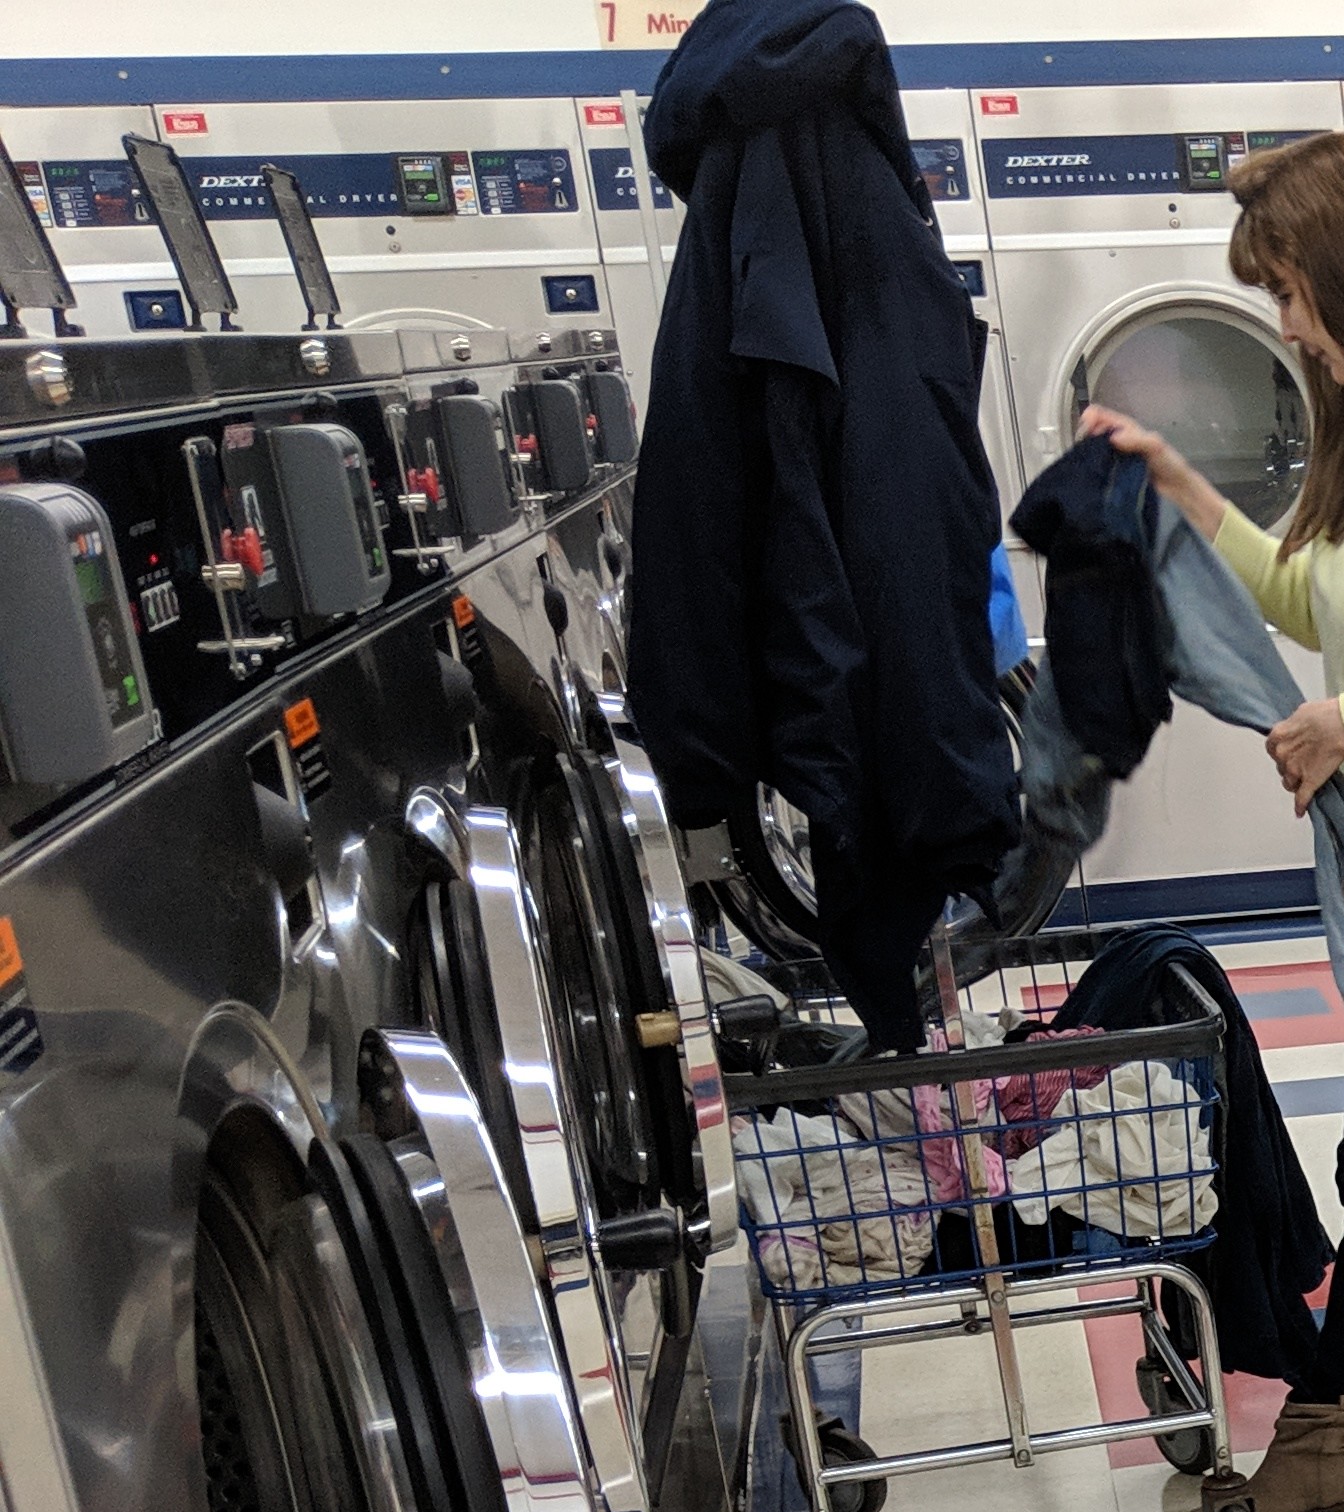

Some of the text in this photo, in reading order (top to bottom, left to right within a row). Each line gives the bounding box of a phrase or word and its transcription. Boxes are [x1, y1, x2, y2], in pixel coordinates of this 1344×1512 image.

[1005, 154, 1090, 167] DEXTER
[1006, 171, 1180, 185] COMMERCIAL DRYER
[202, 193, 398, 206] COMMEAL DRYER
